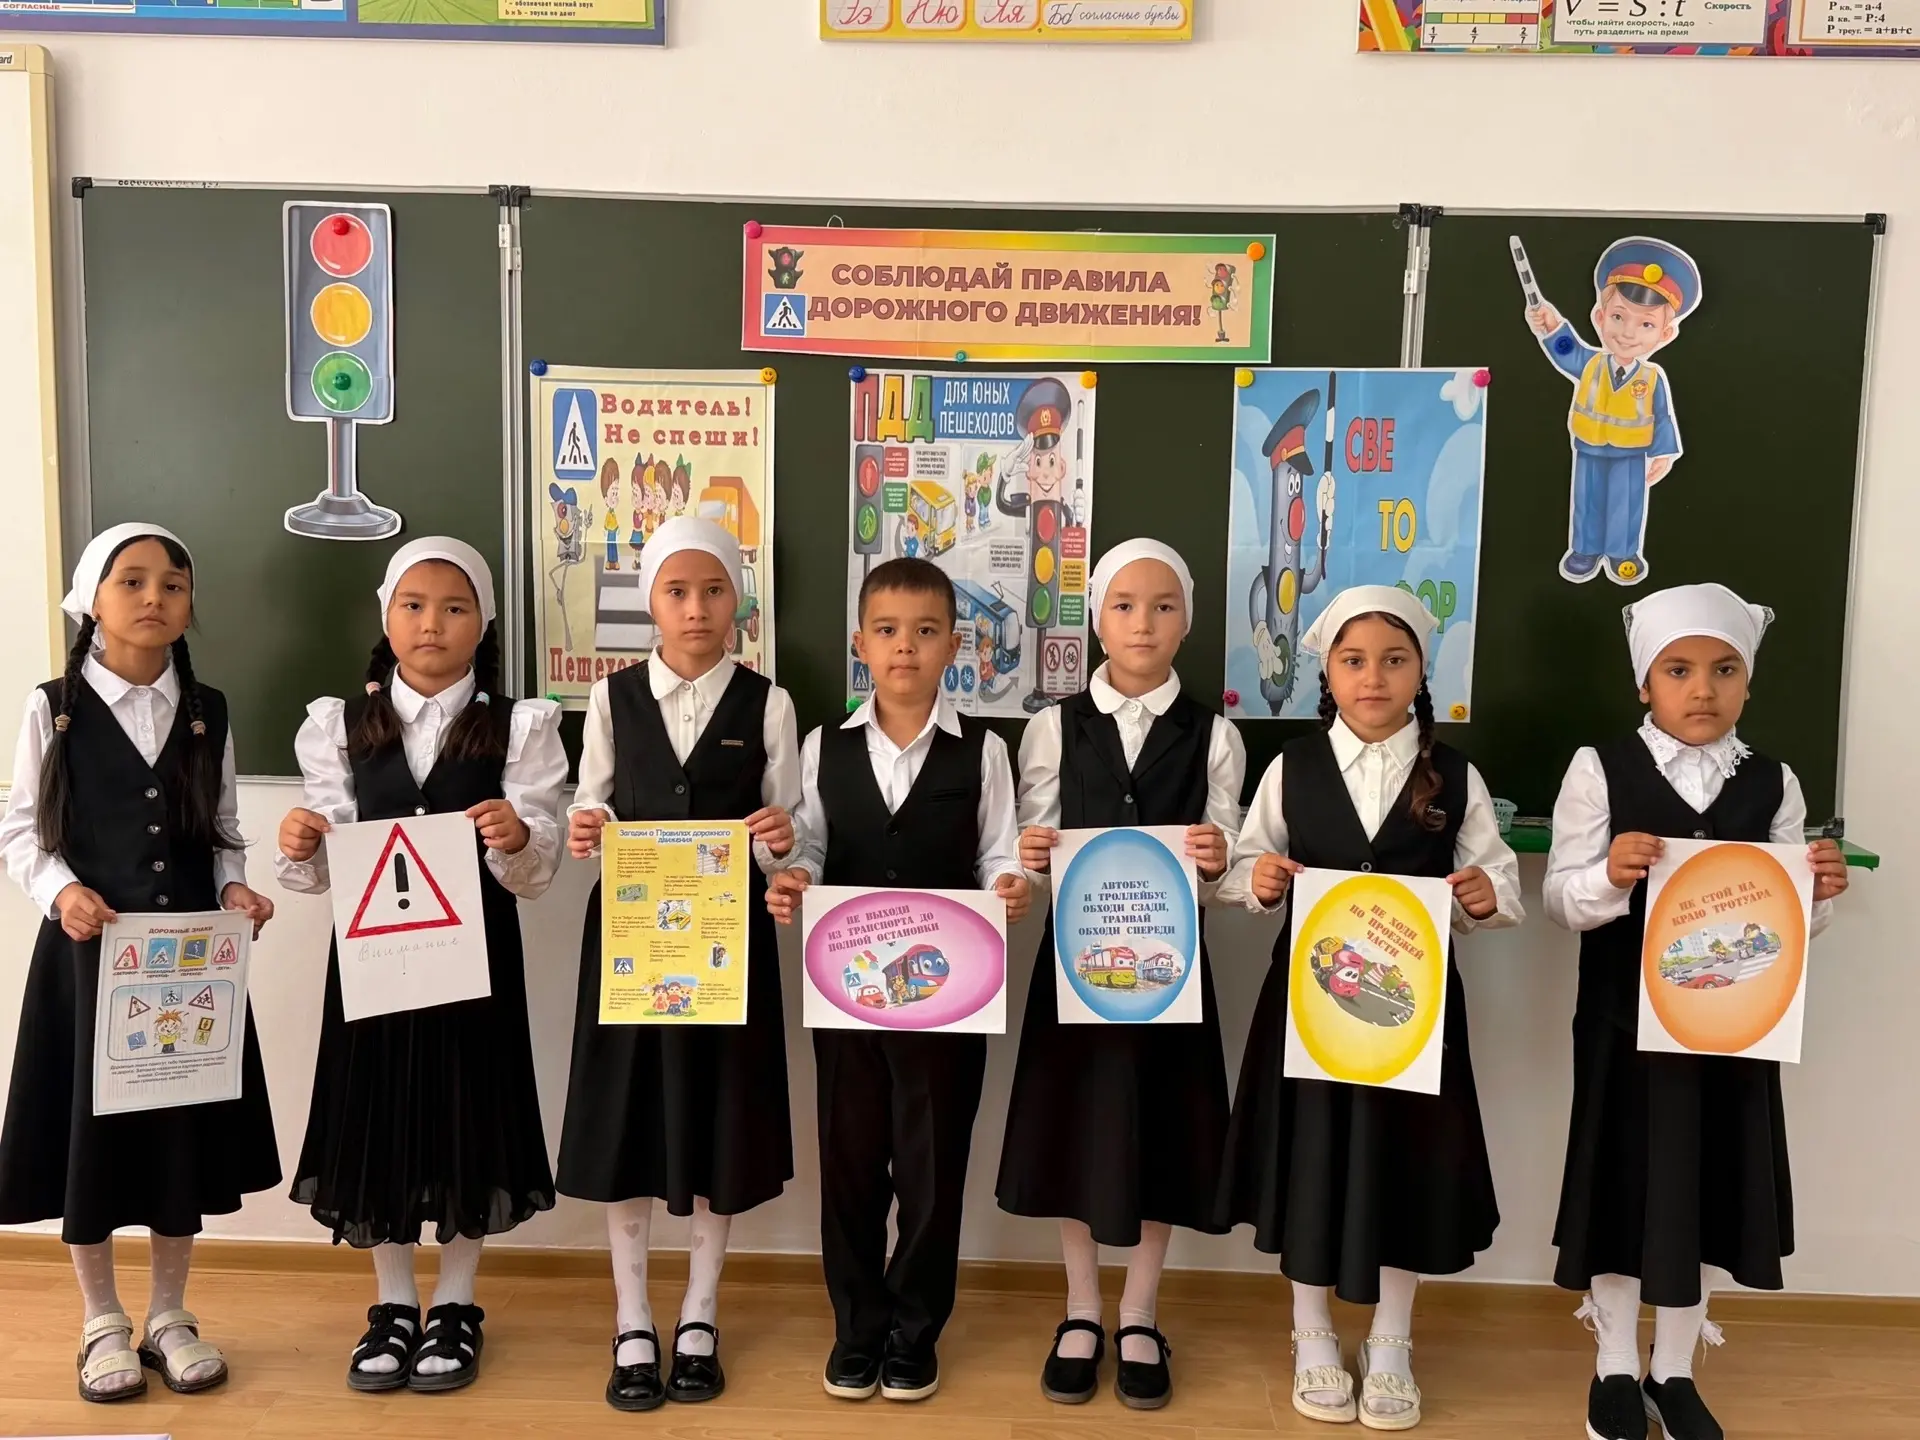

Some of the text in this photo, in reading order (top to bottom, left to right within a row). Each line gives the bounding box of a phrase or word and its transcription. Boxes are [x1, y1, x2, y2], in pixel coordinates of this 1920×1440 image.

[1079, 10, 1141, 21] согласные
[1144, 4, 1181, 26] буквы
[1704, 1, 1752, 10] Скорость
[1573, 29, 1595, 37] путь
[1597, 29, 1645, 37] разделить
[1597, 18, 1624, 26] найти
[1626, 20, 1670, 28] скорость,
[1672, 20, 1695, 28] надо
[831, 262, 1171, 293] СОБЛЮДАЙ ПРАВИЛА
[808, 295, 1202, 328] ДОРОЖНОГО ДВИЖЕНИЯ!
[600, 392, 752, 418] Водитель!
[943, 381, 1010, 406] ДЛЯ ЮНЫХ
[854, 374, 935, 444] ПДД
[604, 423, 760, 447] Не спеши!
[939, 411, 1016, 437] ПЕШЕХОДОВ
[1344, 416, 1396, 473] СВЕ
[1377, 497, 1417, 553] ТО
[1395, 578, 1457, 634] ОР
[550, 647, 640, 683] Пешех
[619, 829, 648, 838] Загадки
[656, 828, 692, 837] Правилах
[692, 830, 731, 838] дорожного
[1084, 889, 1168, 902] И ТРОЛЛЕЙБУС
[1101, 880, 1150, 889] АВТОБУС
[1701, 886, 1733, 904] СТОЙ
[1738, 880, 1756, 893] НА
[846, 904, 910, 925] НЕ ВЫХОДИ
[1082, 902, 1169, 913] ОБХОДИ СЗАДИ,
[1101, 913, 1151, 924] ТРАМВАЙ
[1671, 888, 1772, 927] КРАЮ ТРОТУАРА
[827, 911, 935, 941] ИЗ ТРАНСПОРТА ДО
[1078, 925, 1175, 936] ОБХОДИ СПЕРЕДИ
[1349, 903, 1425, 961] ПО ПРОЕЗЖЕЙ
[1370, 904, 1418, 941] НЕ ХОДИ
[358, 937, 459, 962] Внимание
[828, 922, 940, 953] ПОЛНОЙ ОСТАНОВКИ
[1366, 930, 1400, 958] ЧАСТИ
